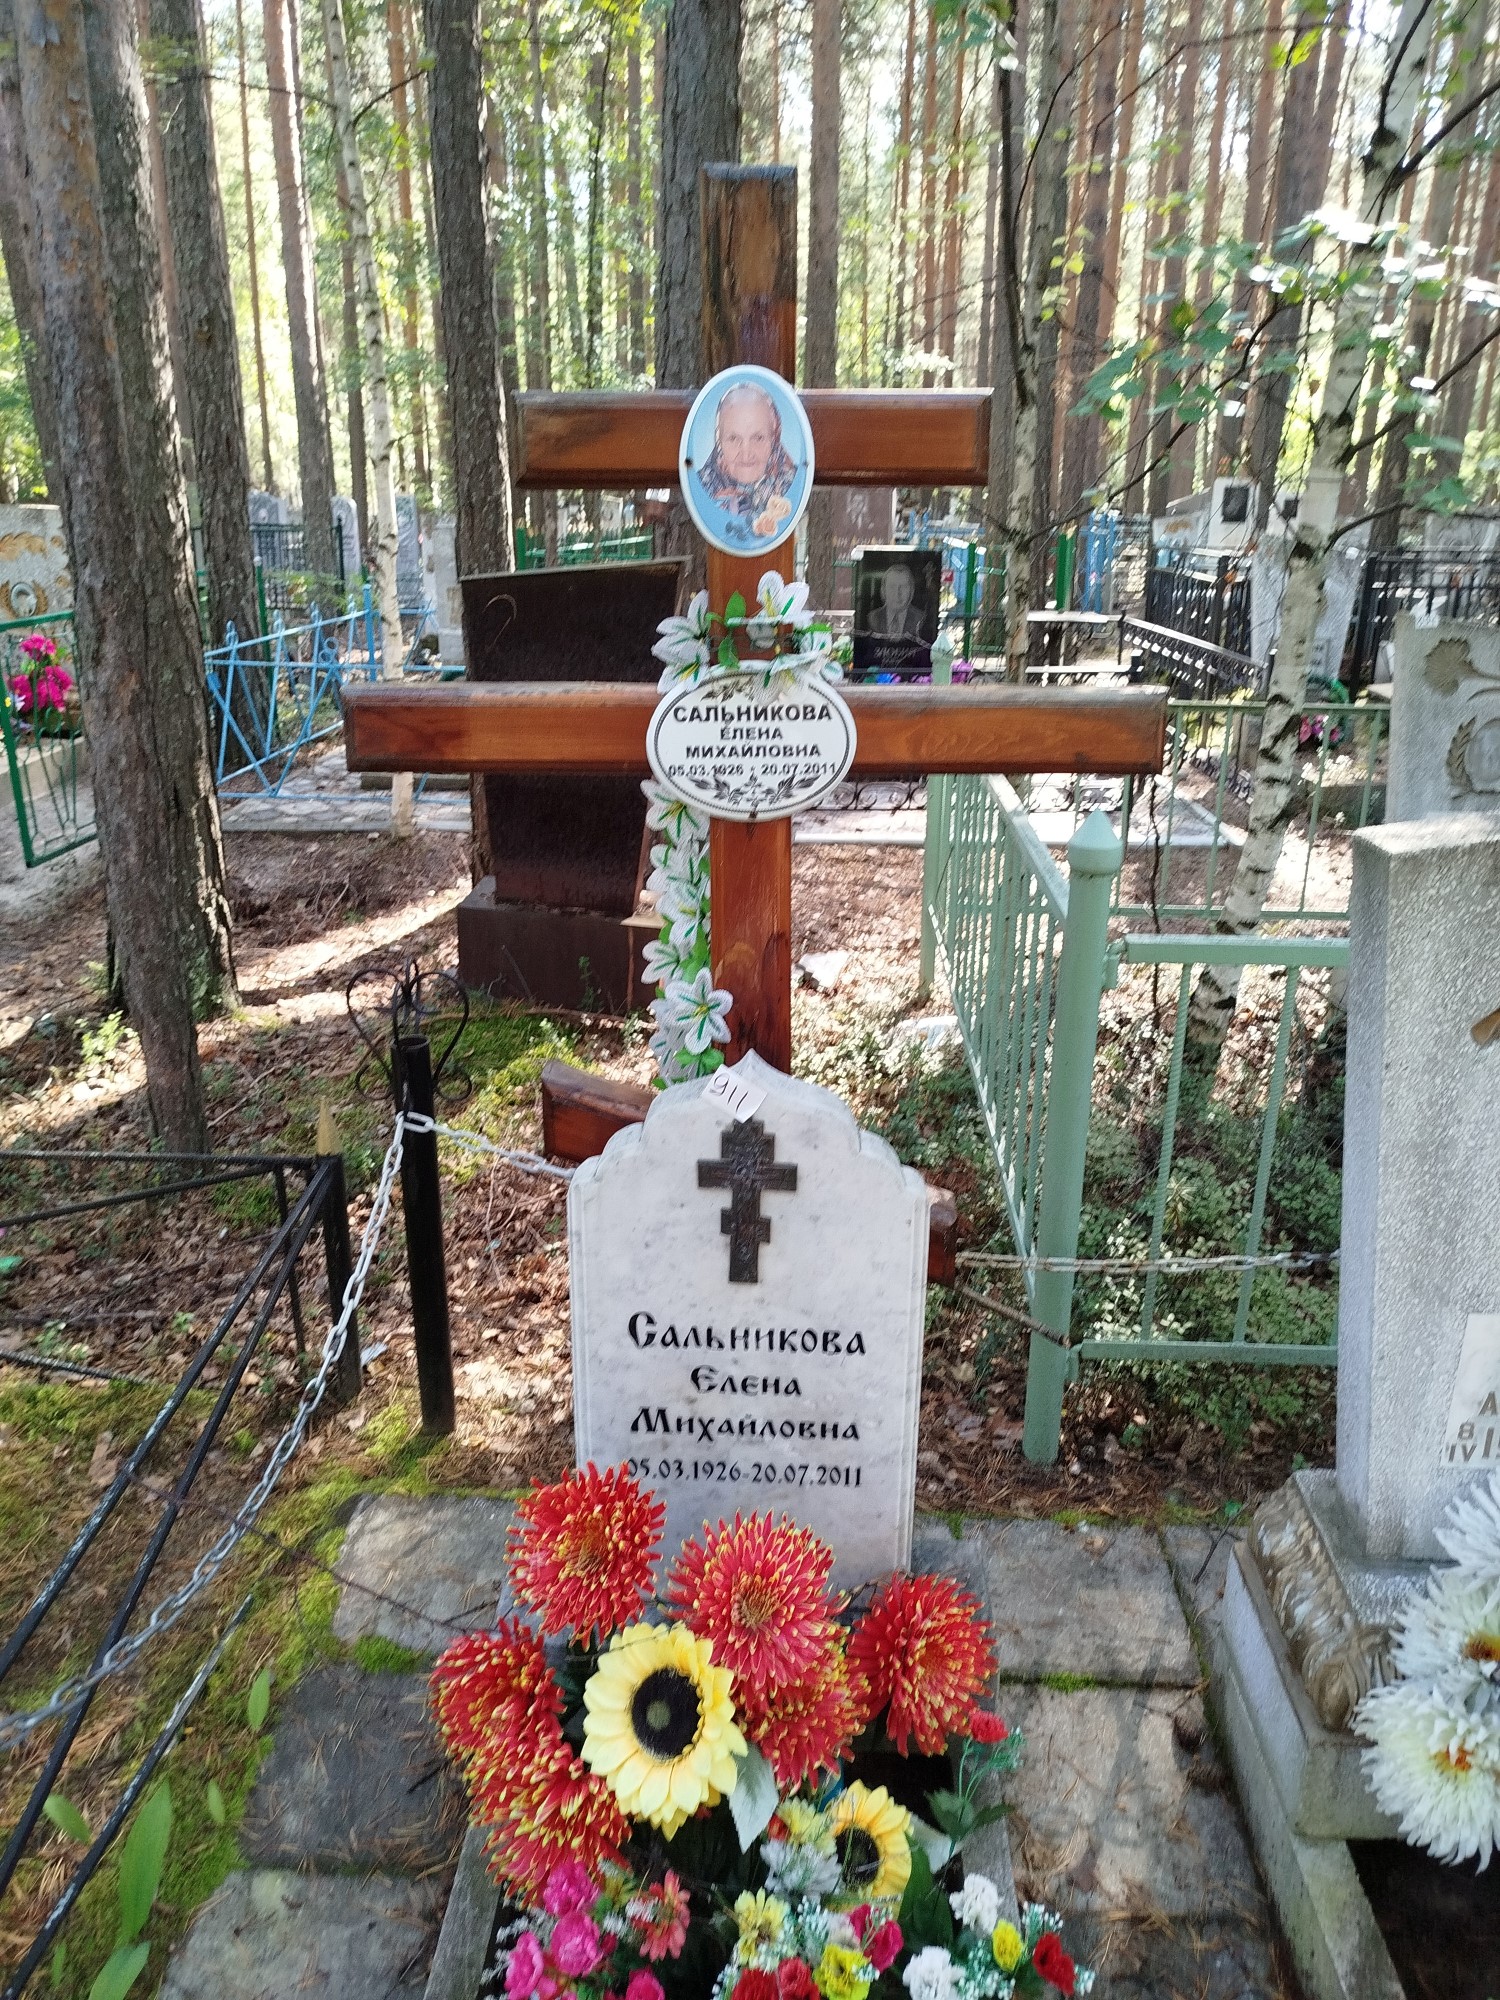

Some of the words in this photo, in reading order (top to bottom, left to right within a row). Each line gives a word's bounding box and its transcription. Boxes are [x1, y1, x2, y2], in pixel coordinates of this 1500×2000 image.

[673, 704, 832, 723] САЛЬНИКОВА
[686, 740, 821, 758] МИХАЙЛОВНА
[720, 727, 783, 740] ЕЛЕНА
[709, 1072, 749, 1114] 911
[628, 1311, 867, 1356] Сальникова
[690, 1364, 802, 1397] Елена
[629, 1407, 860, 1442] Михайловна
